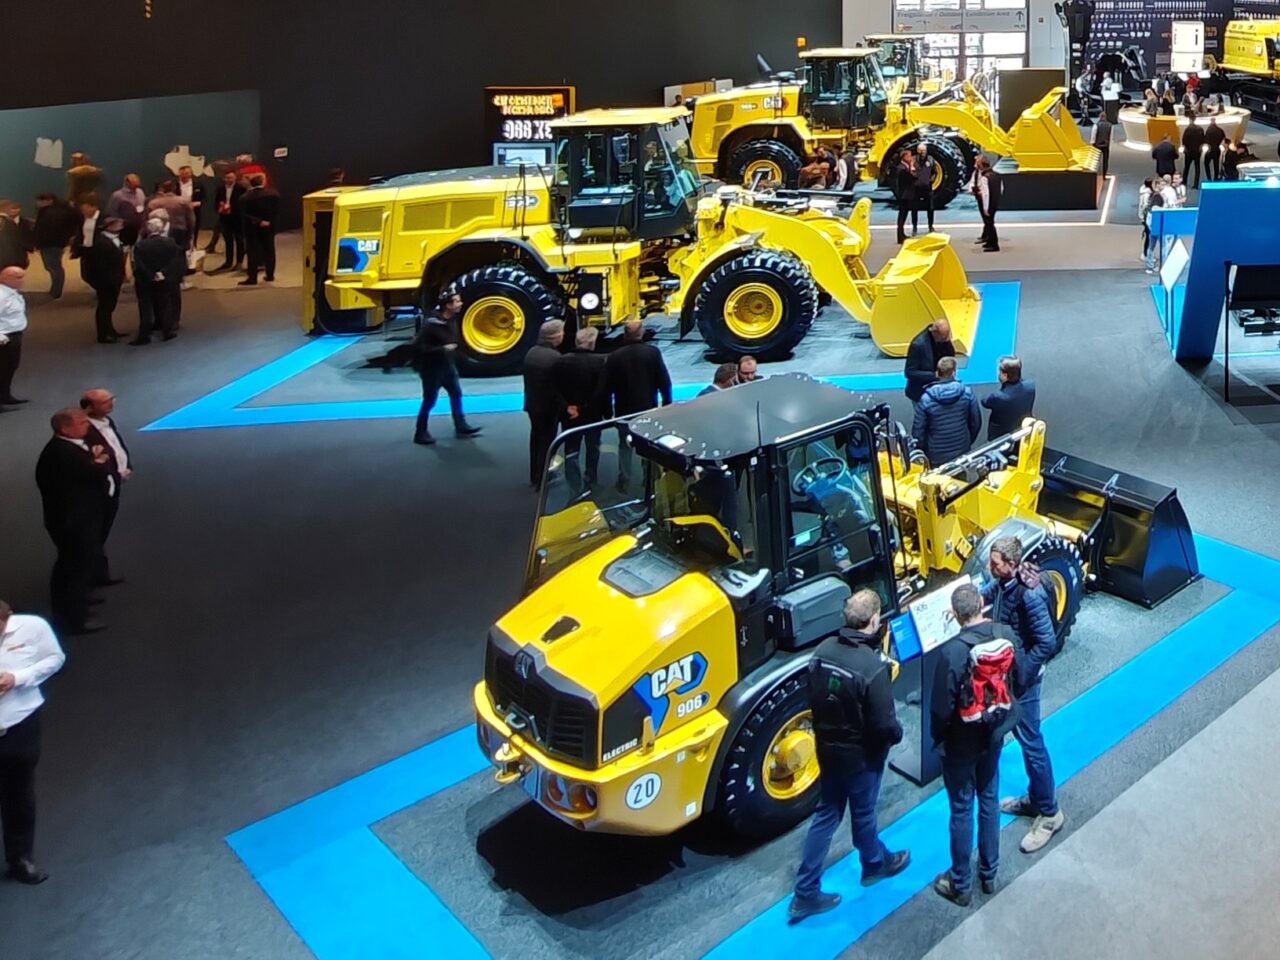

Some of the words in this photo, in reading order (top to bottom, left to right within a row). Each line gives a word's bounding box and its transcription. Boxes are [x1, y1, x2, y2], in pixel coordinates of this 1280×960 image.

[358, 240, 378, 251] CAT
[652, 655, 694, 698] CAT
[678, 695, 702, 718] 906
[603, 738, 638, 762] ELECTRIC
[633, 778, 655, 804] 20
